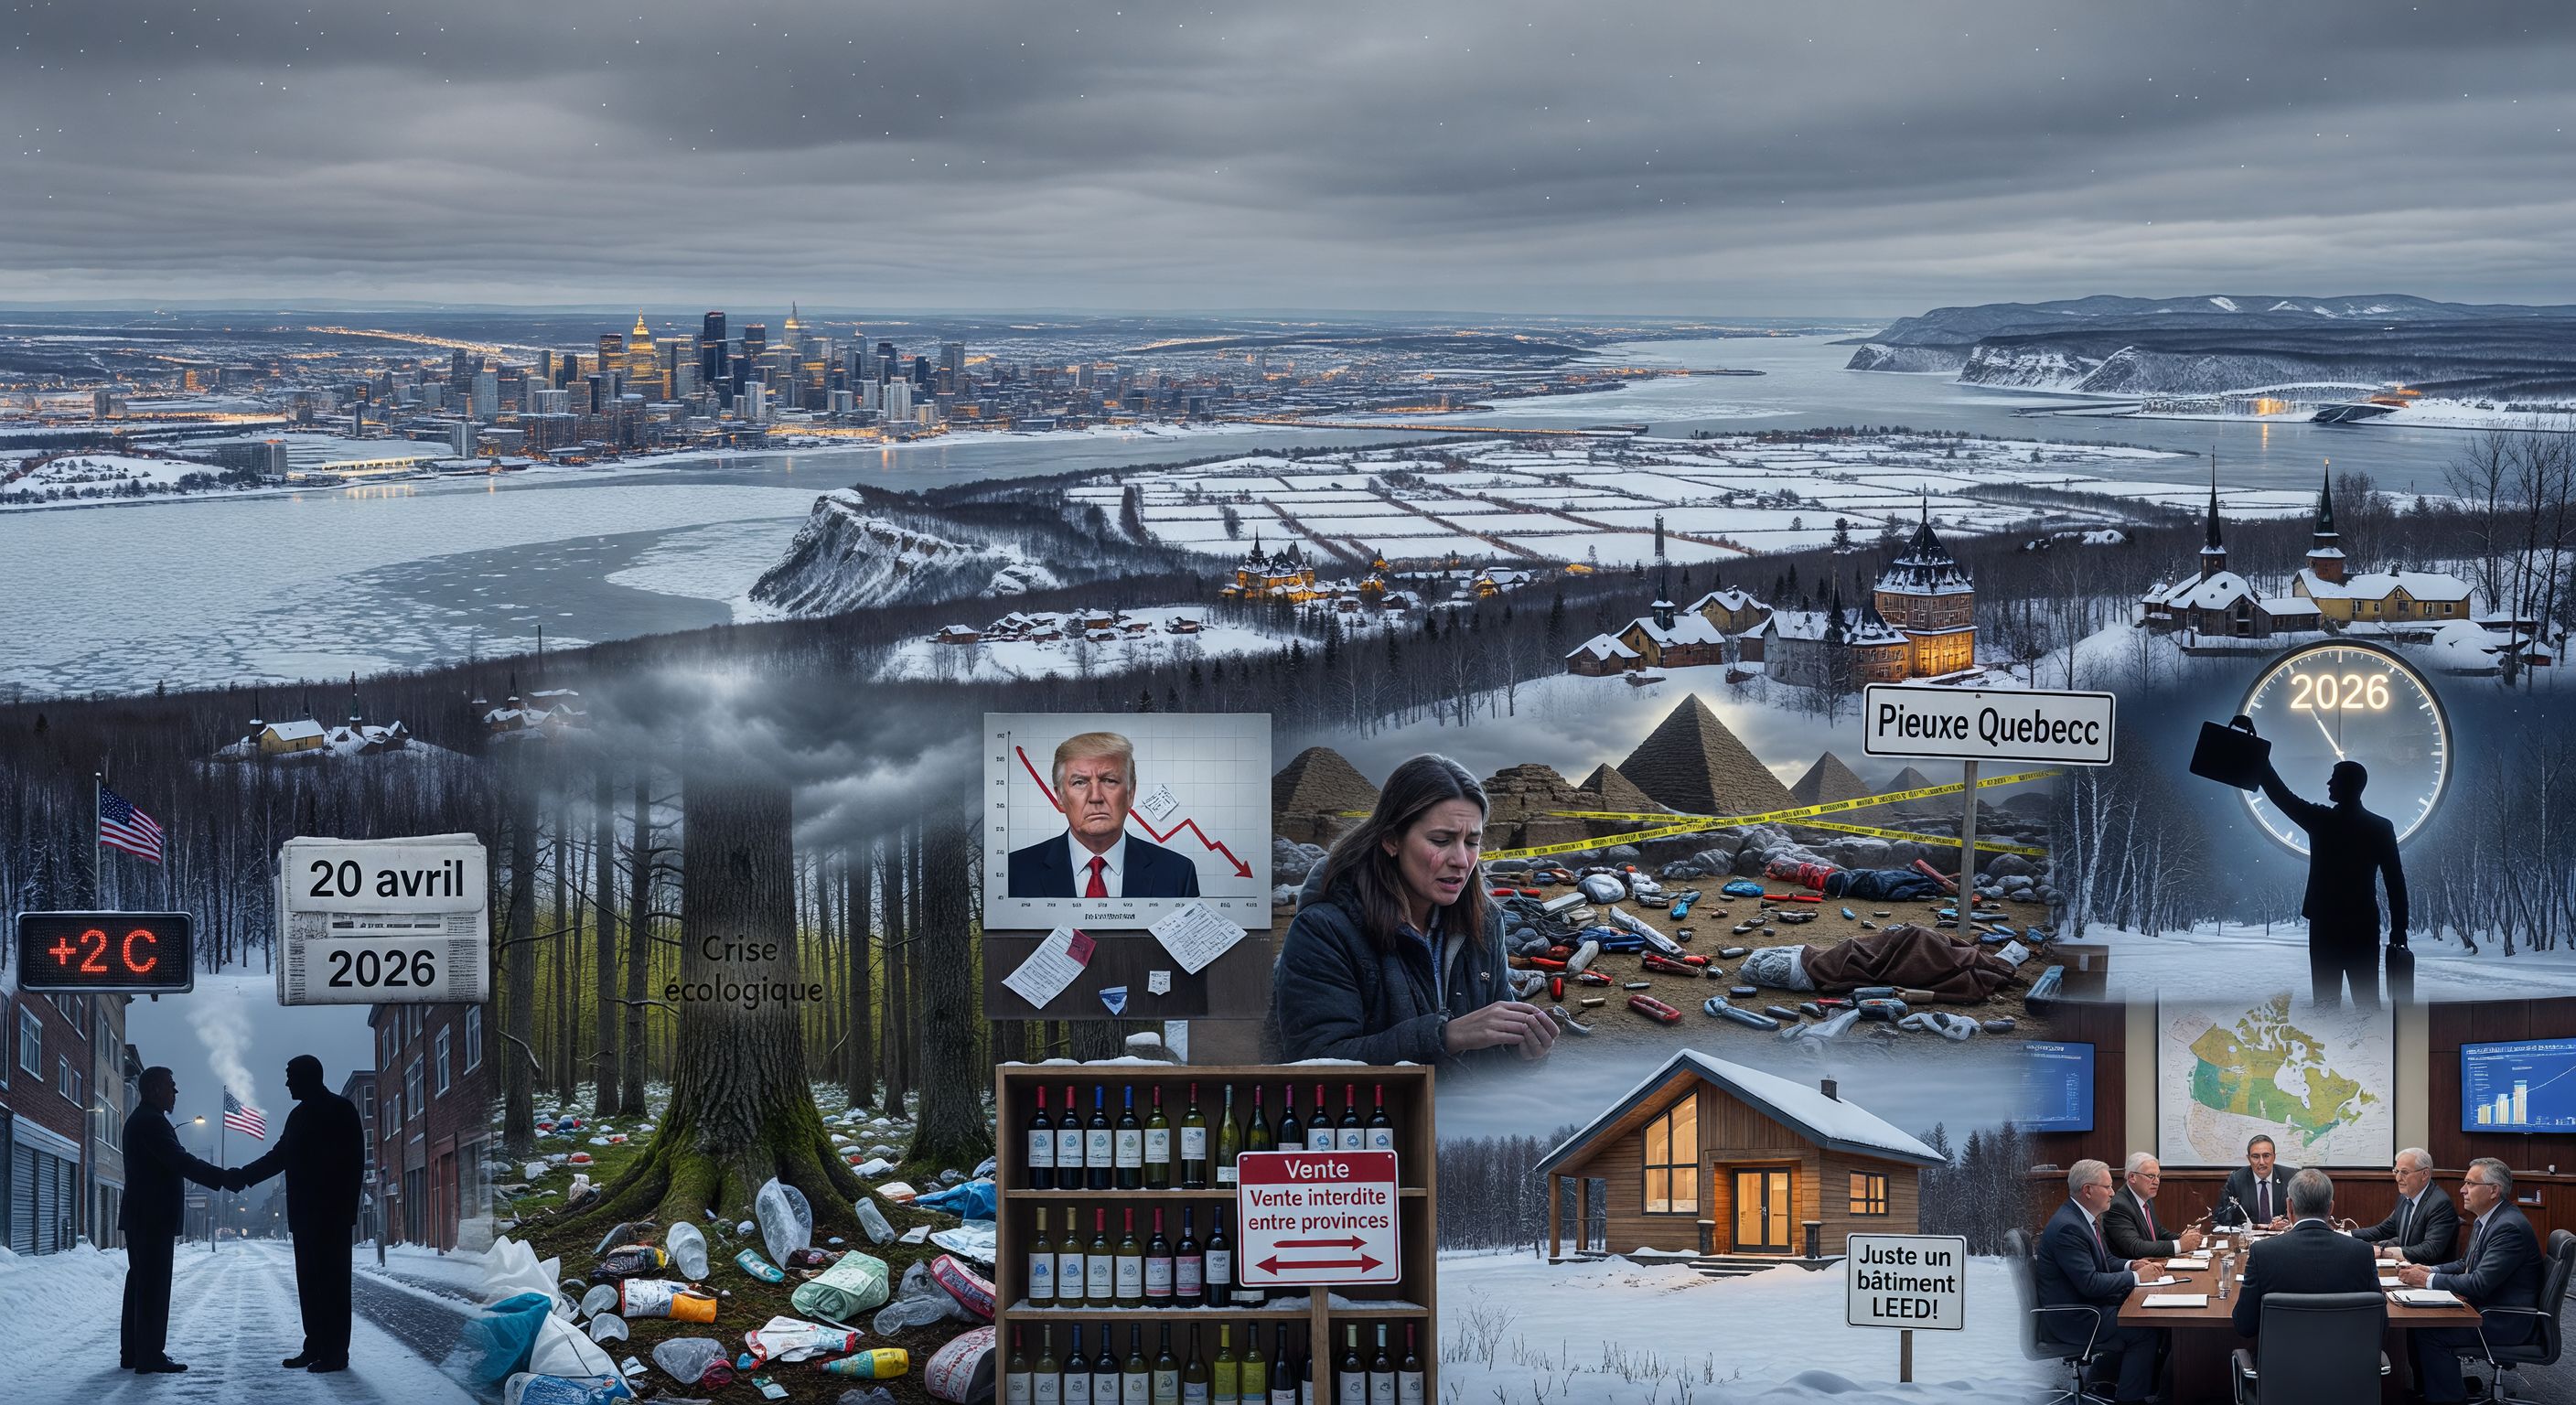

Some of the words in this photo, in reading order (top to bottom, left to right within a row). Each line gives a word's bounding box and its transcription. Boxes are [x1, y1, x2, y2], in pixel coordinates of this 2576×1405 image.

[2290, 673, 2390, 710] 2026
[1878, 703, 1969, 740] Pieuxe
[1978, 707, 2099, 747] Quebecc
[310, 860, 362, 897] 20
[376, 860, 464, 897] avril
[48, 929, 108, 973] +2
[123, 929, 157, 973] C
[703, 934, 778, 962] Crise
[328, 949, 435, 988] 2026
[664, 972, 823, 1011] écologique
[1284, 1159, 1349, 1179] Vente
[1250, 1189, 1303, 1207] Vente
[1308, 1187, 1386, 1207] interdite
[1249, 1214, 1296, 1230] entre
[1302, 1212, 1390, 1234] provinces
[1859, 1244, 1917, 1266] Juste
[1925, 1250, 1951, 1267] un
[1858, 1269, 1955, 1293] bâtiment
[1873, 1297, 1938, 1320] LEED!
